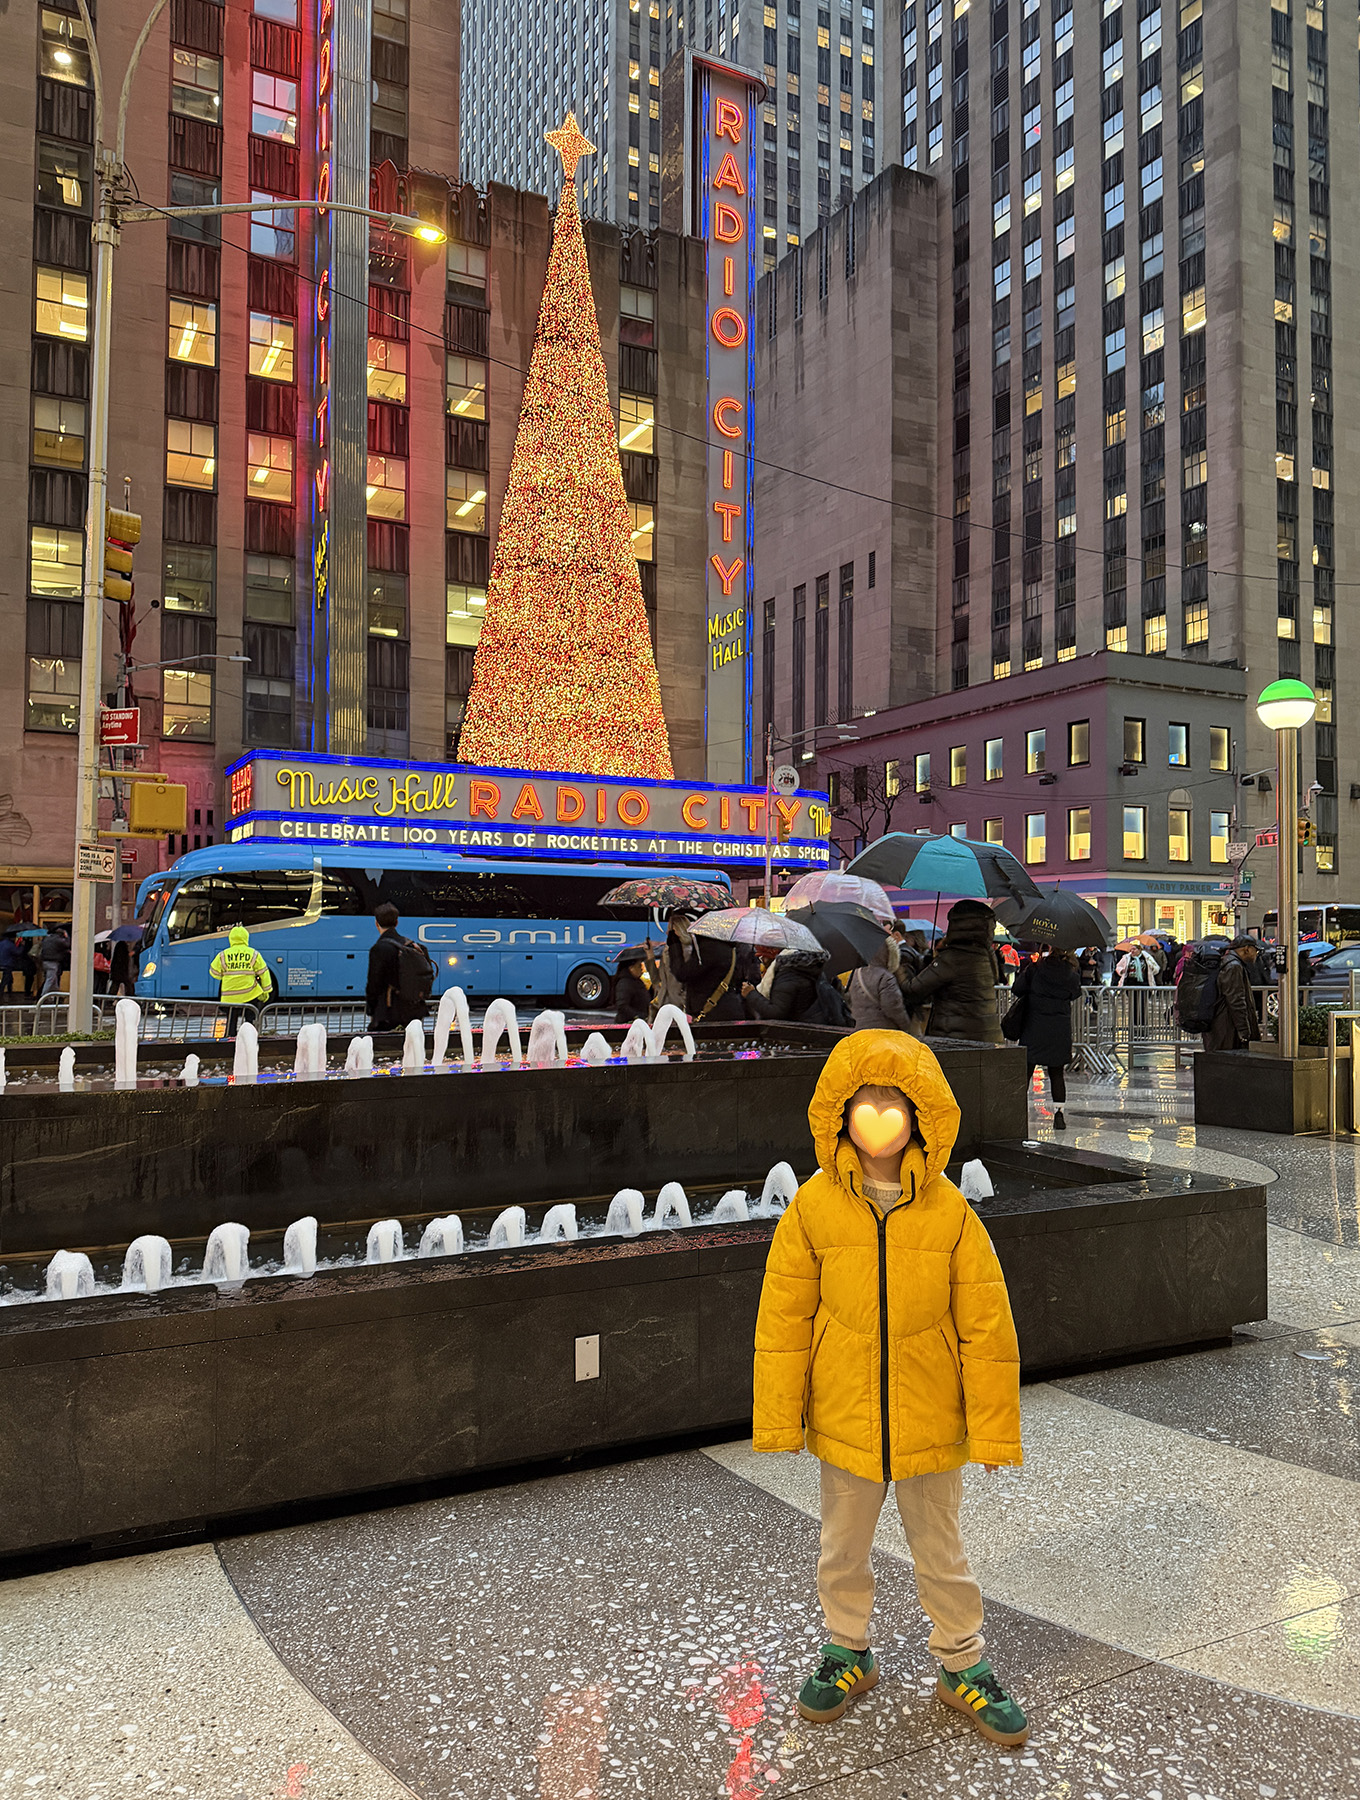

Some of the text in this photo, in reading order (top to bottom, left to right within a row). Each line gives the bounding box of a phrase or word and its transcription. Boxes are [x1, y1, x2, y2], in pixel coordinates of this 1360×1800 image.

[711, 97, 747, 348] RADIO
[315, 268, 329, 513] CITY
[711, 396, 744, 595] CITY
[708, 607, 744, 644] MUSIC
[712, 638, 744, 671] HALL
[102, 712, 133, 721] NO STANDING
[102, 721, 122, 730] Anytime
[231, 787, 252, 815] CITY
[276, 768, 379, 809] Music
[373, 773, 458, 816] Hall
[470, 779, 650, 826] RADIO
[682, 793, 802, 832] CITY
[279, 821, 390, 841] CELEBRATE
[403, 826, 437, 843] 100
[449, 830, 502, 846] YEARS
[513, 833, 536, 847] OF
[547, 834, 638, 851] ROCKETTES
[648, 839, 667, 853] AT
[678, 841, 703, 854] THE
[1146, 882, 1176, 891] WARBY
[1179, 883, 1212, 892] PARKER
[418, 923, 627, 944] Camila
[1032, 918, 1059, 931] ROYAL
[227, 952, 251, 961] NYPD
